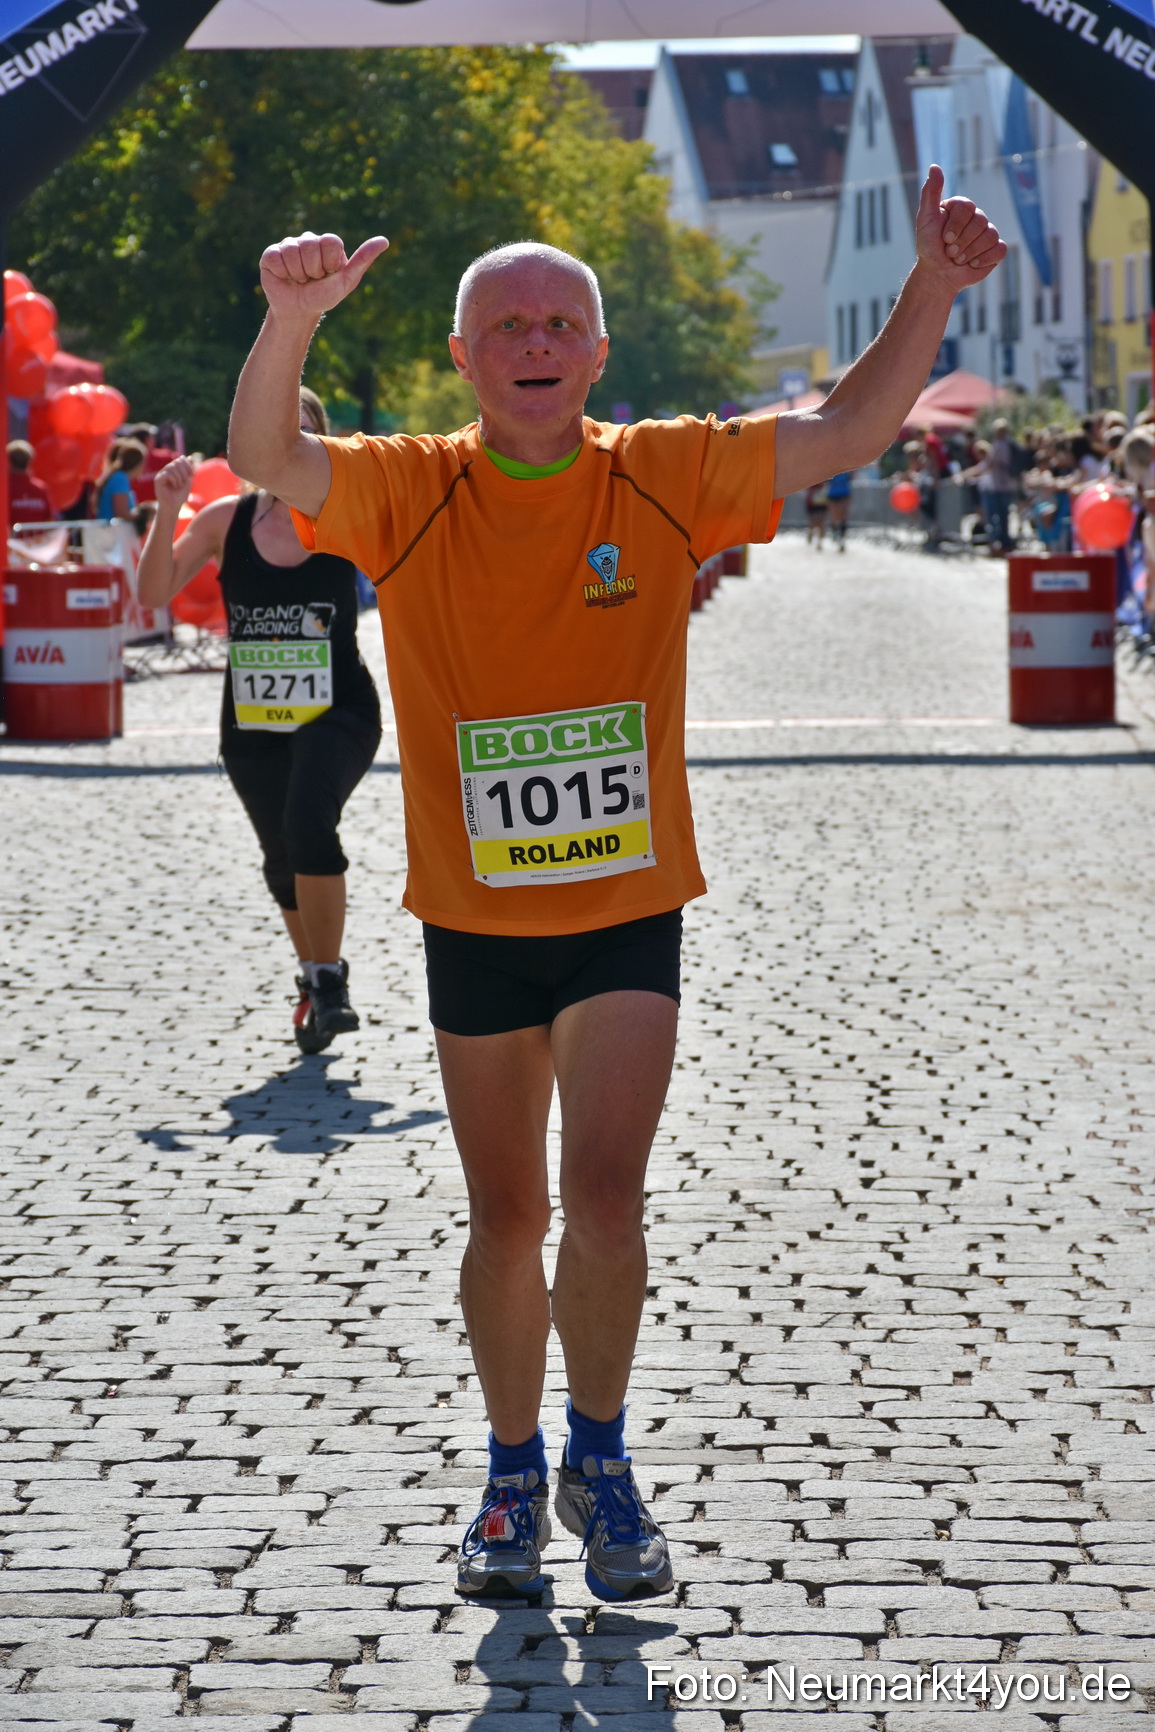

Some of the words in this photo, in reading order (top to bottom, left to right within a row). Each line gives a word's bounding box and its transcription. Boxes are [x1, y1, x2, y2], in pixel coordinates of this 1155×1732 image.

[0, 0, 139, 96] EUMARK
[583, 576, 635, 600] INFERNO
[15, 641, 65, 664] AVIA
[236, 645, 320, 666] BOCK
[244, 674, 315, 700] 1271
[266, 709, 294, 721] EVA
[470, 710, 633, 765] BOCK
[485, 764, 630, 829] 1015
[508, 834, 621, 865] ROLAND
